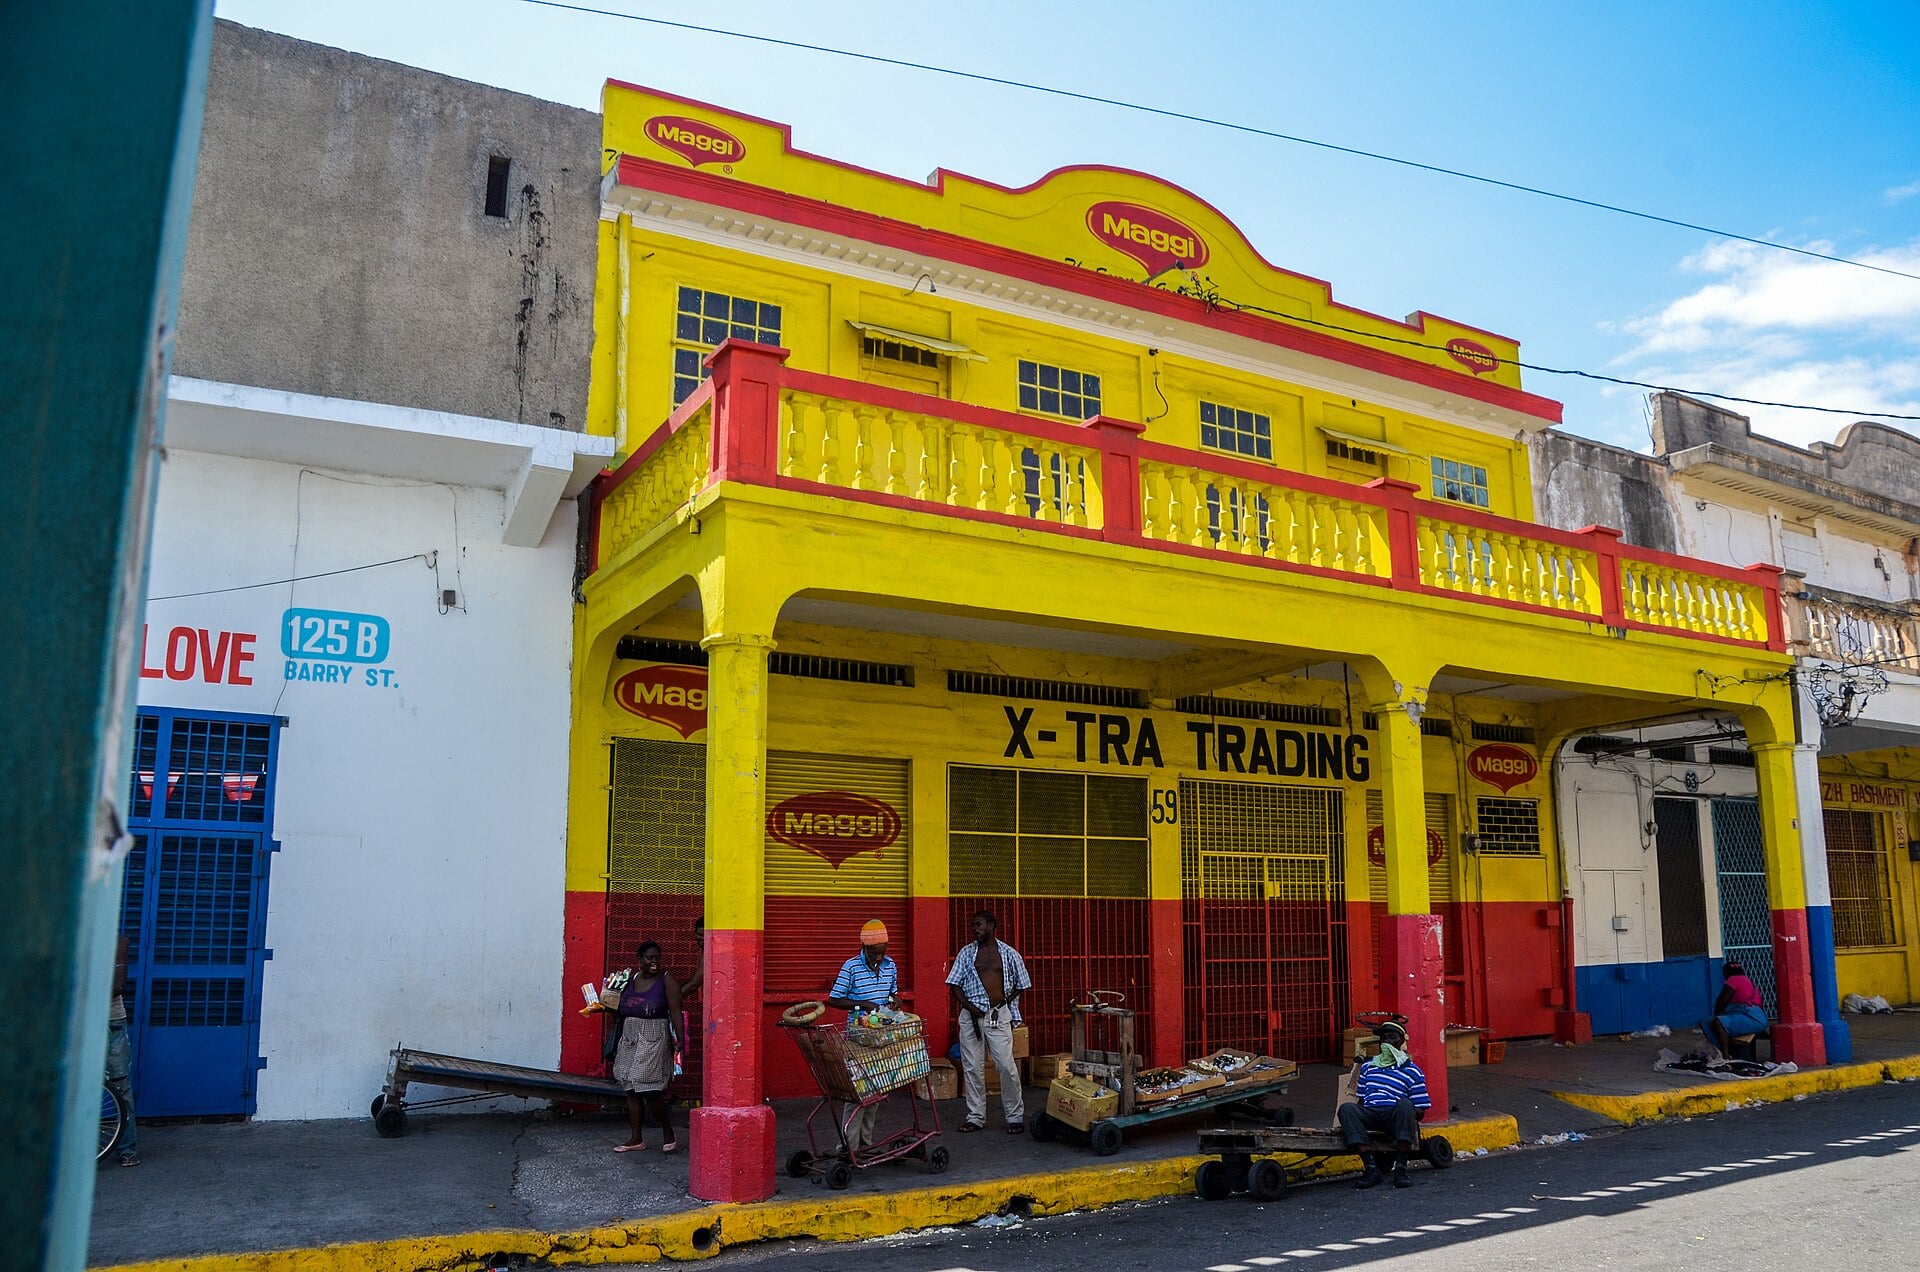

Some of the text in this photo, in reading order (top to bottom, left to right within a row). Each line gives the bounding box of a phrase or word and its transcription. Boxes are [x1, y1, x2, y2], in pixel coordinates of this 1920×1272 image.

[657, 123, 733, 155] Maggi
[1103, 213, 1195, 258] Maggi
[1452, 344, 1493, 366] Maggi
[288, 615, 350, 655] 125
[139, 624, 256, 686] LOVE
[284, 660, 400, 689] BARRY ST.
[634, 682, 708, 711] Mag
[1187, 721, 1370, 782] TRADING
[1476, 756, 1528, 774] Maggi
[1151, 789, 1178, 824] 59
[1850, 784, 1906, 807] BASHMENT
[784, 811, 884, 838] Maggi
